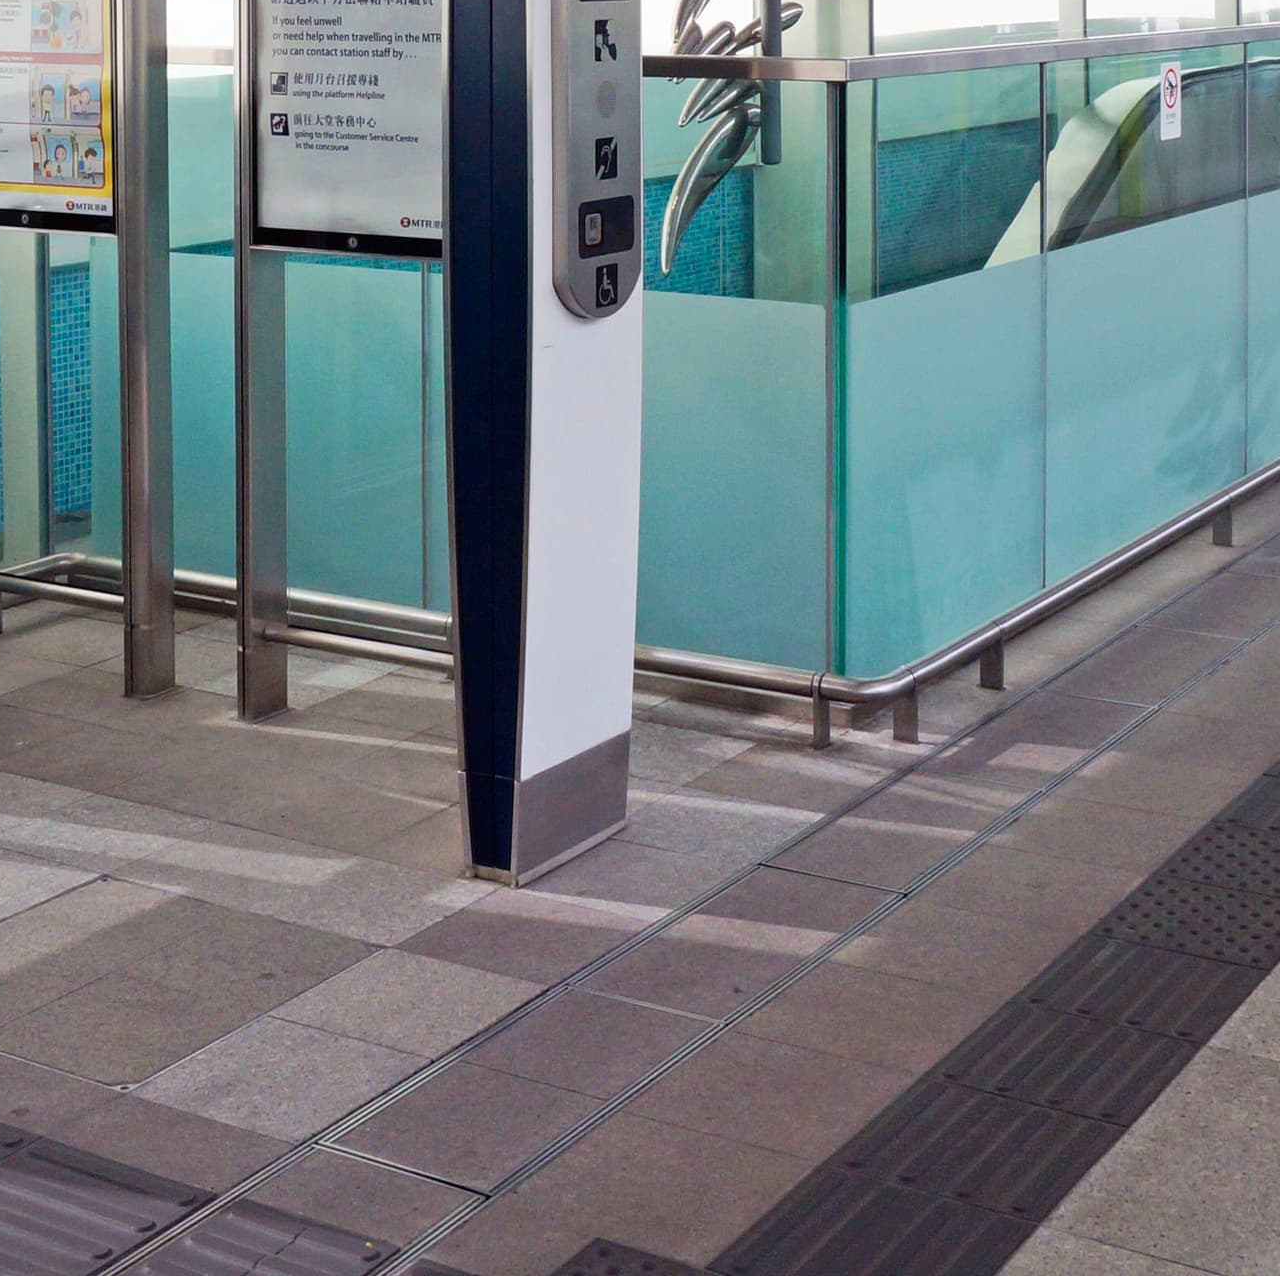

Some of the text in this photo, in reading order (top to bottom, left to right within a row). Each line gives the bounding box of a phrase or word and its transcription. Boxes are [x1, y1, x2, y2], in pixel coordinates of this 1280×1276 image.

[280, 17, 295, 27] you
[296, 14, 312, 26] feel
[314, 15, 342, 26] unwell
[272, 30, 442, 44] or need help when travelling in the MTR
[272, 48, 288, 58] you
[289, 47, 304, 56] can
[306, 47, 338, 57] contact
[340, 46, 370, 57] station
[371, 46, 391, 58] staff
[392, 47, 404, 60] by
[292, 89, 385, 101] using the platform Helpline
[294, 131, 419, 143] going to the Customer Service Centre
[295, 141, 349, 151] in the concourse
